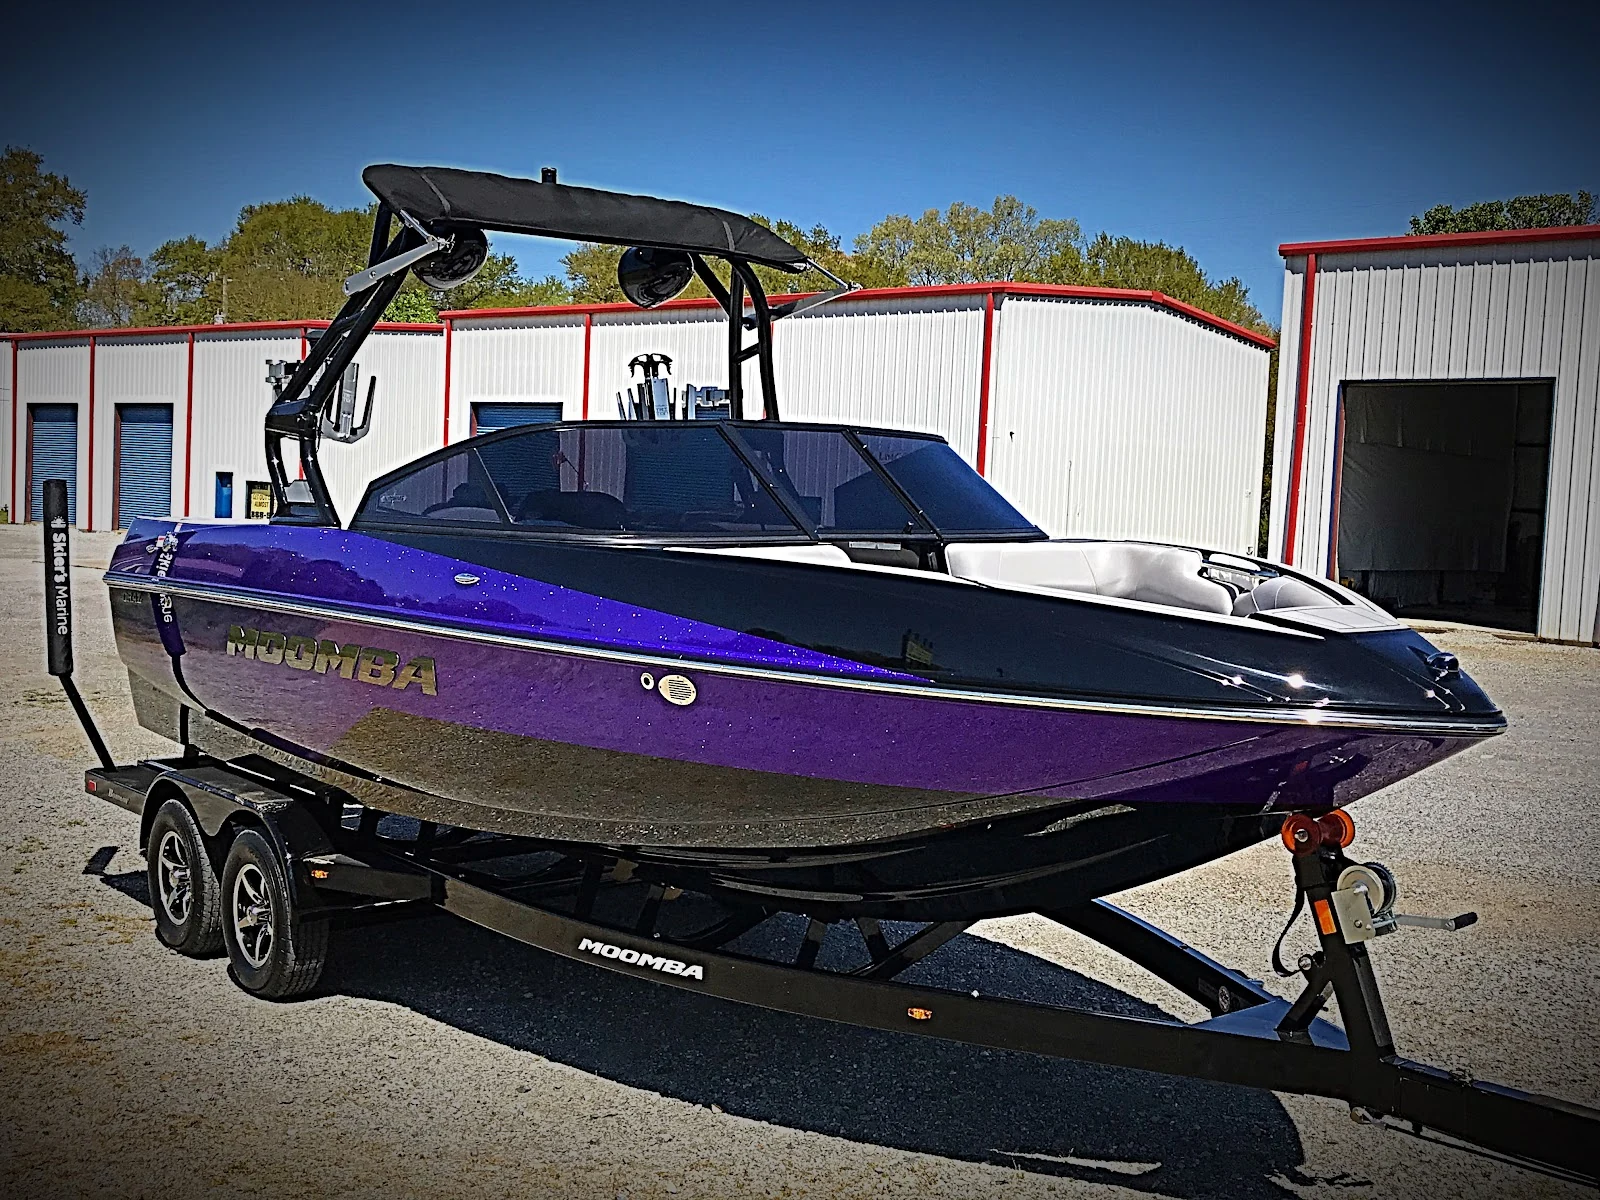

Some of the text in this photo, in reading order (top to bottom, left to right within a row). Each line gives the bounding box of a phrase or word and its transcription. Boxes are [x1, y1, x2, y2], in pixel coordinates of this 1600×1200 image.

[53, 532, 70, 635] Skier's Marine
[226, 624, 438, 696] MOOMBA
[578, 938, 703, 980] MOOMBA
